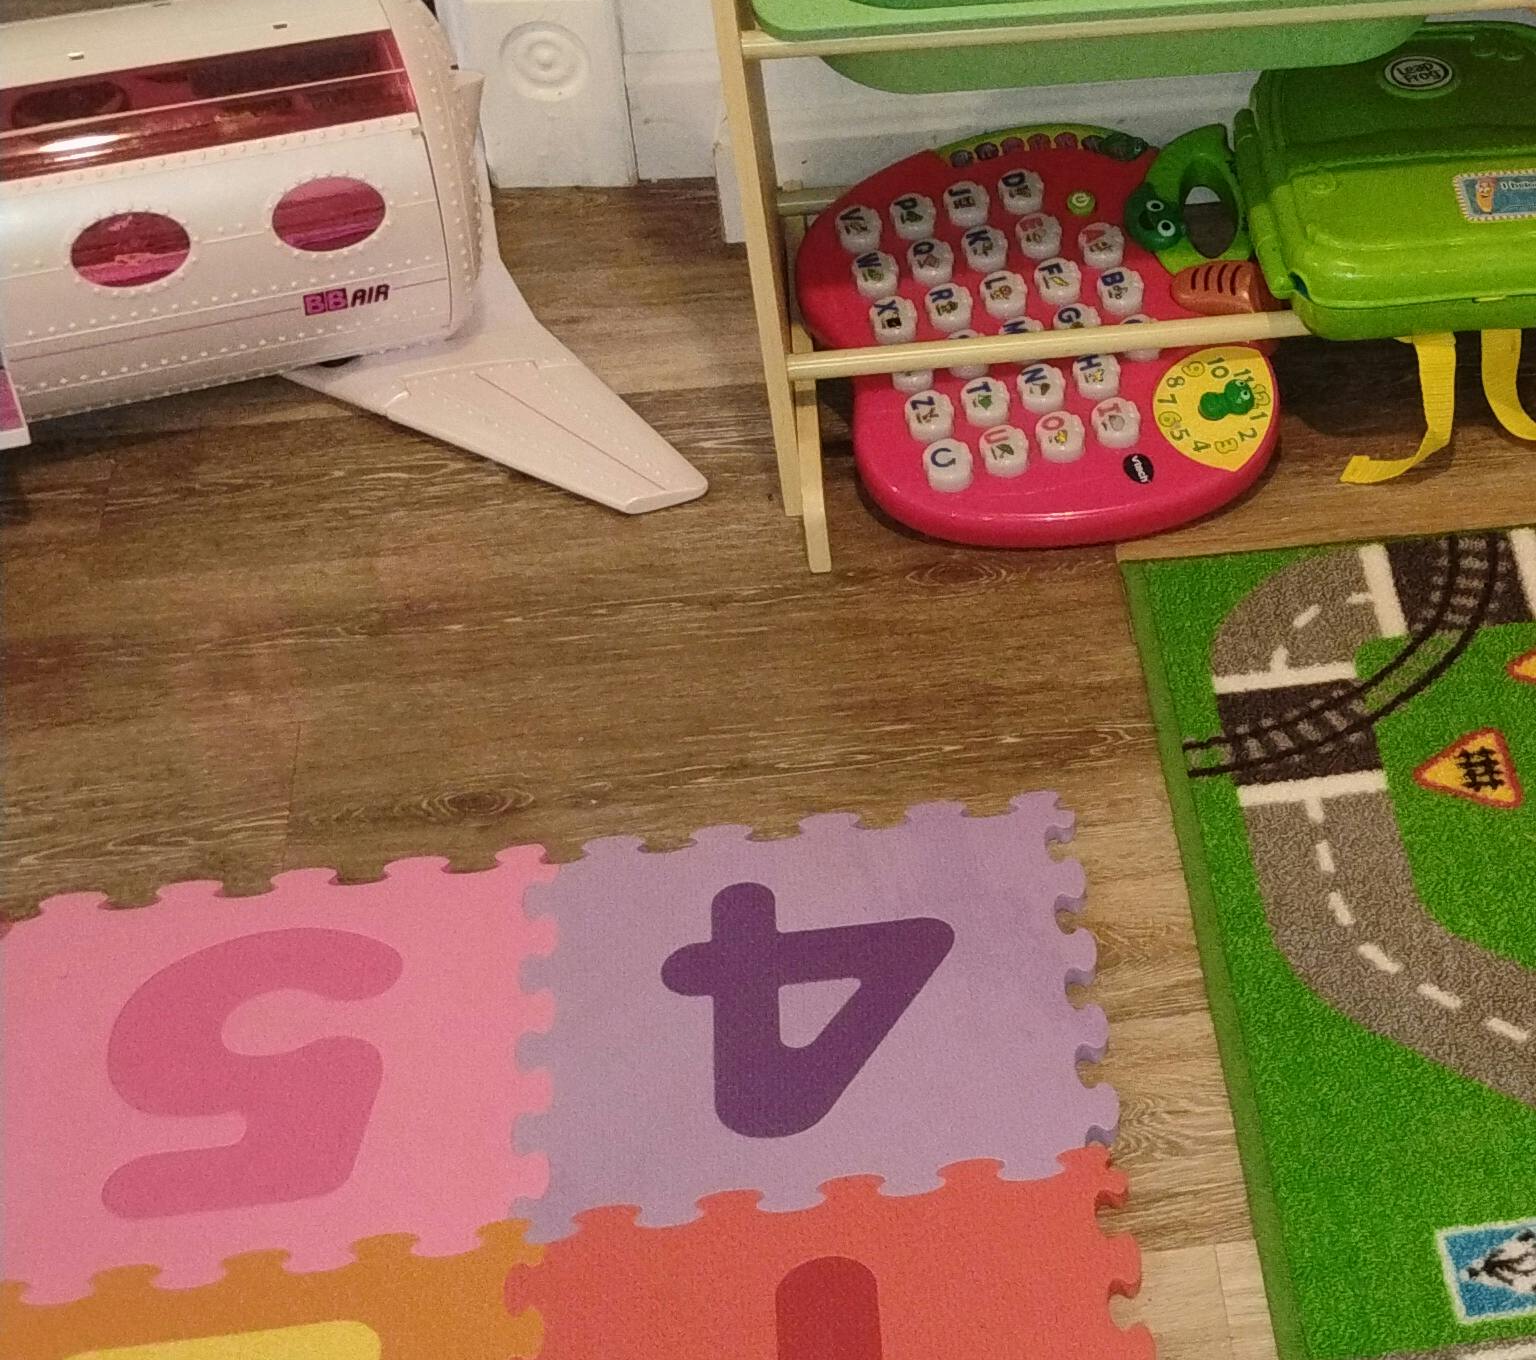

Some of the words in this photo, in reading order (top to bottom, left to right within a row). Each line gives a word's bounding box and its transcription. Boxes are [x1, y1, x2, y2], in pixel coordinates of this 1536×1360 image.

[1002, 172, 1025, 187] D
[894, 197, 917, 211] P
[966, 229, 992, 247] K
[913, 241, 934, 256] Q
[1038, 262, 1063, 277] F
[985, 276, 1006, 290] L
[1101, 271, 1125, 287] B
[350, 283, 390, 308] AIR
[930, 288, 953, 303] R
[874, 300, 898, 317] X
[1058, 307, 1081, 323] G
[1022, 367, 1047, 384] N
[1166, 376, 1185, 388] 8
[966, 381, 992, 394] T
[910, 395, 935, 411] Z
[1157, 393, 1177, 404] 7
[1170, 428, 1190, 441] 5
[1237, 427, 1257, 441] 2
[1193, 440, 1211, 452] 4
[660, 882, 956, 1139] 4
[101, 927, 403, 1220] 5
